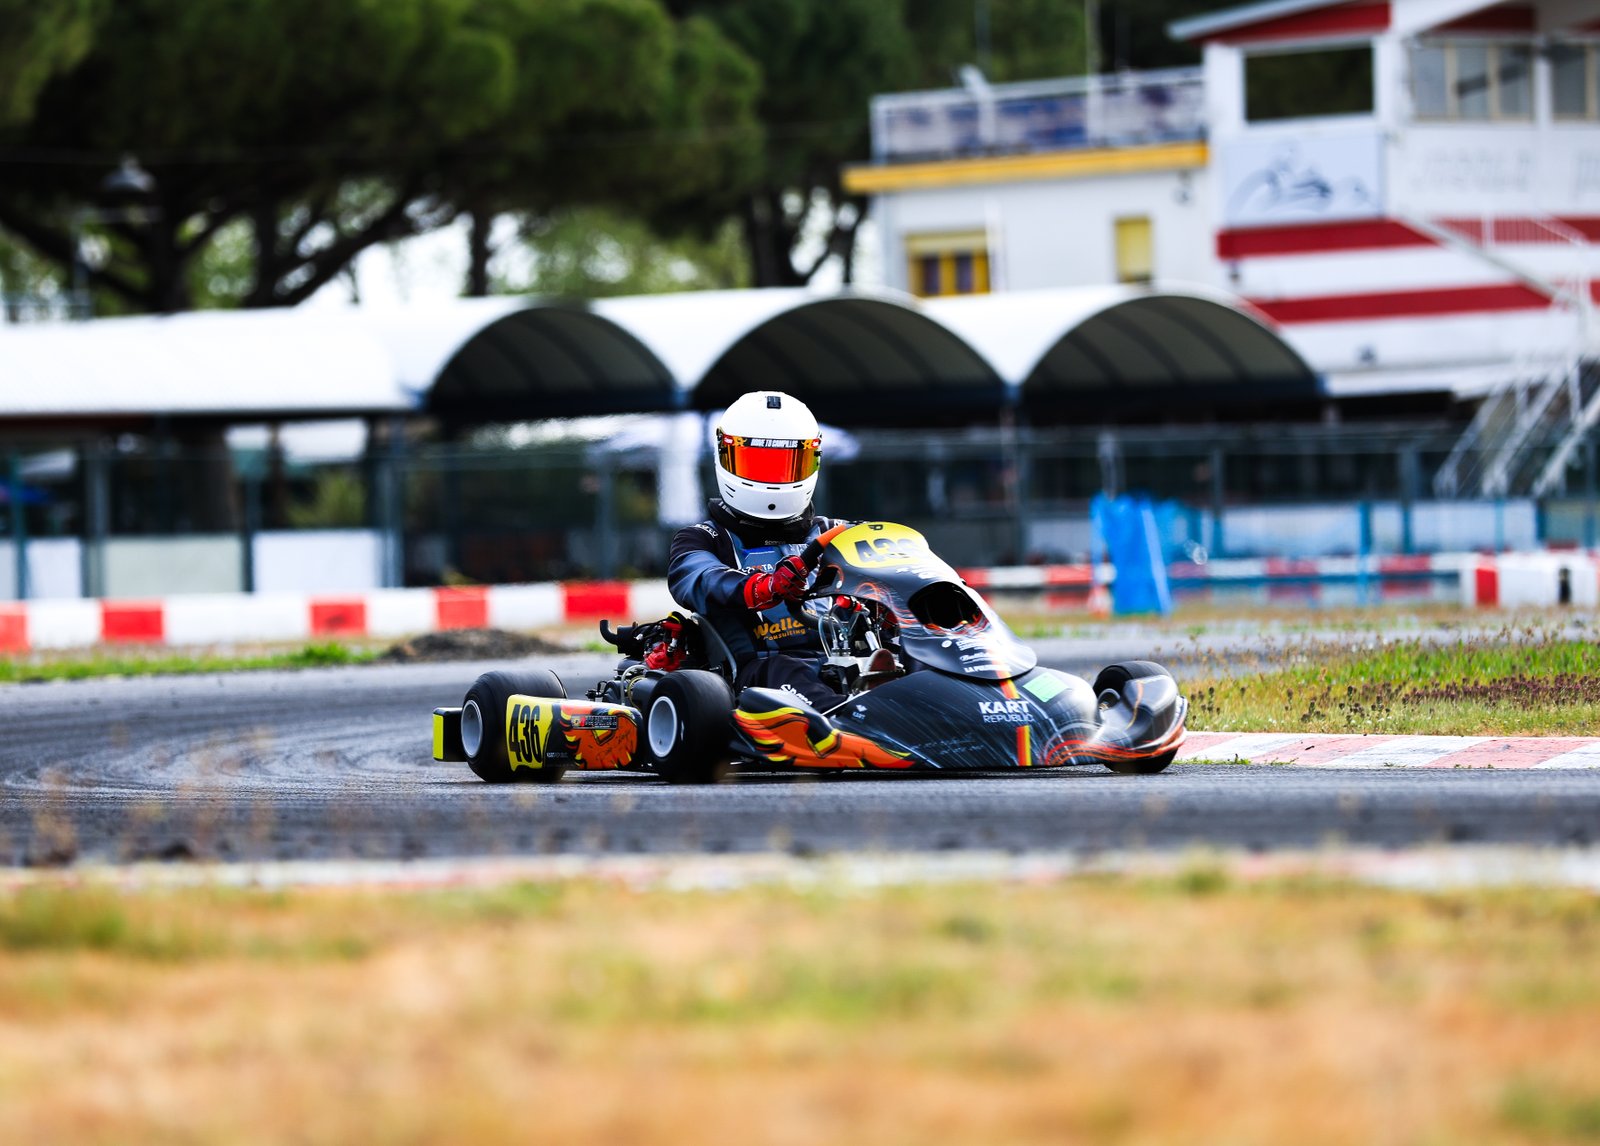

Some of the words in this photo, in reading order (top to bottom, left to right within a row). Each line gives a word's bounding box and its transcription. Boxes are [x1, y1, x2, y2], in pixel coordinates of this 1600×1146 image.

[978, 700, 1030, 714] KART
[983, 714, 1035, 723] REPUBLIC
[509, 704, 543, 763] 436
